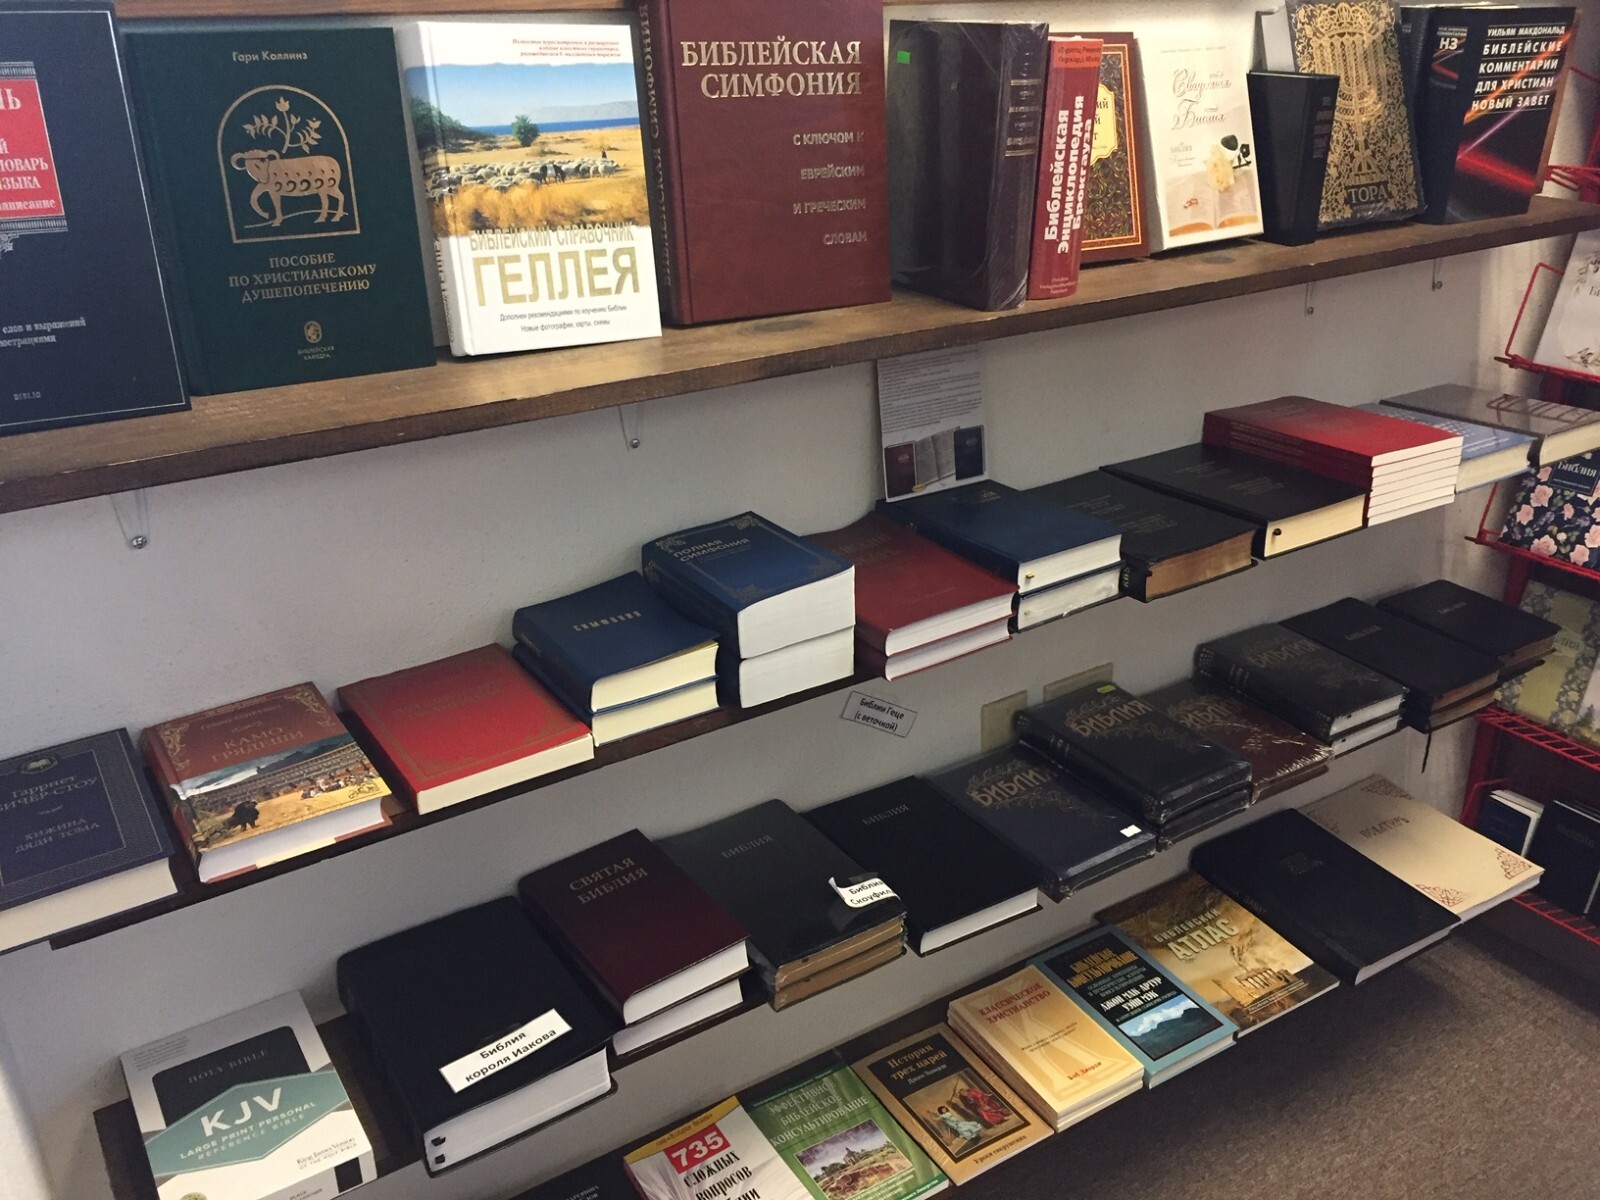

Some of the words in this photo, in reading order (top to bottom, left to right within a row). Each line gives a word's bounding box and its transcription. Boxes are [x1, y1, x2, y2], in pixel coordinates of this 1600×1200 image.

[1487, 27, 1516, 37] УИЛЬЯМ
[1517, 26, 1566, 36] МАКДОНАЛЬД
[232, 51, 259, 64] Гари
[262, 50, 308, 61] Коллинз
[680, 35, 862, 67] БИБЛЕЙСКАЯ
[1482, 40, 1563, 56] БИБЛЕЙСКИЕ
[1478, 59, 1559, 74] КОММЕНТАРИИ
[701, 72, 862, 98] СИМФОНИЯ
[1474, 80, 1497, 94] ДЛЯ
[1500, 77, 1554, 90] ХРИСТИАН
[1471, 95, 1513, 111] НОВЫЙ
[1516, 94, 1550, 107] ЗАВЕТ
[793, 133, 801, 146] С
[803, 131, 854, 145] КЛЮЧОМ
[856, 131, 865, 142] К
[800, 163, 865, 180] ЕВРЕЙСКИМ
[1044, 110, 1069, 240] Библейская
[1057, 95, 1084, 254] Энциклопедия
[1072, 118, 1092, 230] Брокгауза
[793, 203, 802, 214] И
[804, 198, 867, 214] ГРЕЧЕСКИМ
[1348, 184, 1388, 203] ТОРА
[469, 222, 552, 252] БИБЛЕЙСКИЙ
[555, 221, 634, 246] СПРАВОЧНИК
[823, 231, 868, 246] СЛОВАМ
[269, 253, 336, 269] ПОСОБИЕ
[228, 275, 250, 288] ПО
[253, 264, 377, 286] ХРИСТИАНСКОМУ
[472, 246, 641, 307] ГЕЛЛЕЯ
[242, 279, 371, 304] ДУШЕПОПЕЧЕНИЮ
[672, 539, 723, 558] ПОЛНАЯ
[680, 537, 751, 562] СИМФОНИЯ
[860, 697, 886, 713] Библии
[886, 706, 905, 721] Геце
[861, 714, 898, 733] веточкой)
[223, 727, 283, 750] КАМО
[0, 776, 98, 813] ИЧЕР-СТОУ
[11, 775, 77, 799] Гарриет
[15, 835, 53, 854] ДЯДИ
[60, 822, 100, 839] ТОМА
[24, 817, 87, 841] ХИЖИНА
[569, 857, 636, 891] СВЯТАЯ
[576, 867, 649, 905] БИБЛИЯ
[1153, 907, 1222, 944] БИБЛЕЙСКИЙ
[1167, 918, 1240, 961] АТЛАС
[978, 982, 1043, 1016] КЛАССИЧЕСКОЕ
[986, 990, 1051, 1025] ХРИСТИАНСТВО
[465, 1056, 511, 1082] короля
[511, 1029, 557, 1058] Иакова
[479, 1032, 527, 1059] Библия
[887, 1044, 934, 1069] История
[890, 1064, 916, 1081] трех
[915, 1050, 948, 1069] царей
[200, 1086, 283, 1137] KJV
[770, 1095, 870, 1147] КОНСУЛЬТИРОВАНИЕ
[780, 1092, 843, 1126] БИБЛЕЙСКОЕ
[180, 1138, 218, 1160] LARGE
[220, 1125, 254, 1144] PRINT
[258, 1101, 317, 1128] PERSONAL
[671, 1131, 724, 1167] 735
